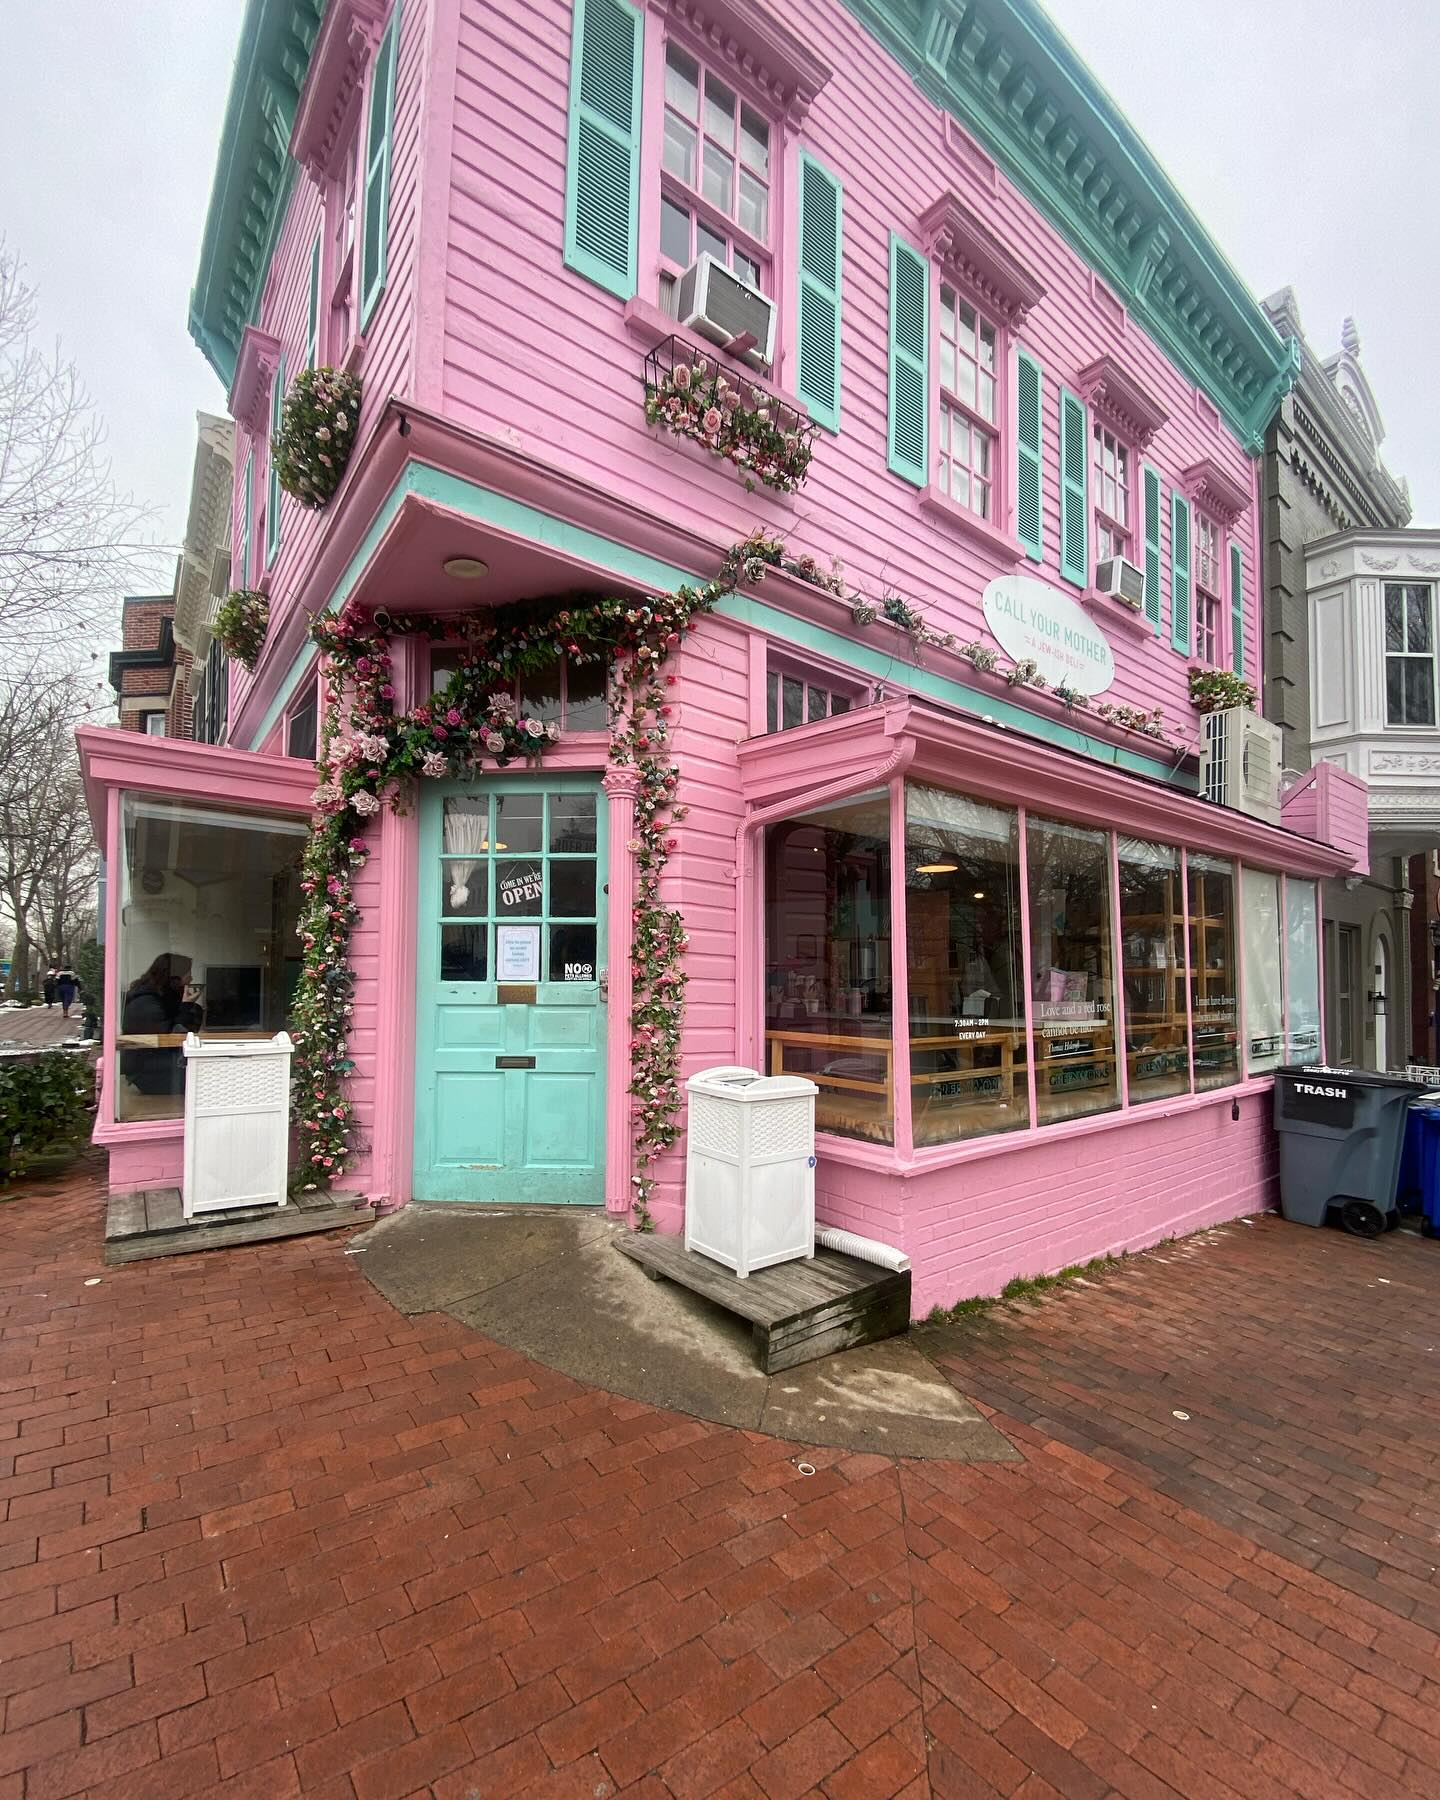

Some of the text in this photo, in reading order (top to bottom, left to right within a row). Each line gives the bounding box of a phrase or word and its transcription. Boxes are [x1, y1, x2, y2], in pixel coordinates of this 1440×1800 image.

[994, 591, 1107, 666] CALL YOUR MOTHER
[500, 880, 517, 890] COME
[516, 877, 523, 886] IN
[502, 881, 544, 905] OPEN
[564, 963, 582, 974] NO
[1041, 1000, 1112, 1018] Love and a red rose
[954, 1019, 974, 1027] 7:30AM
[959, 1031, 987, 1040] EVERY DAY
[1293, 1083, 1346, 1099] TRASH
